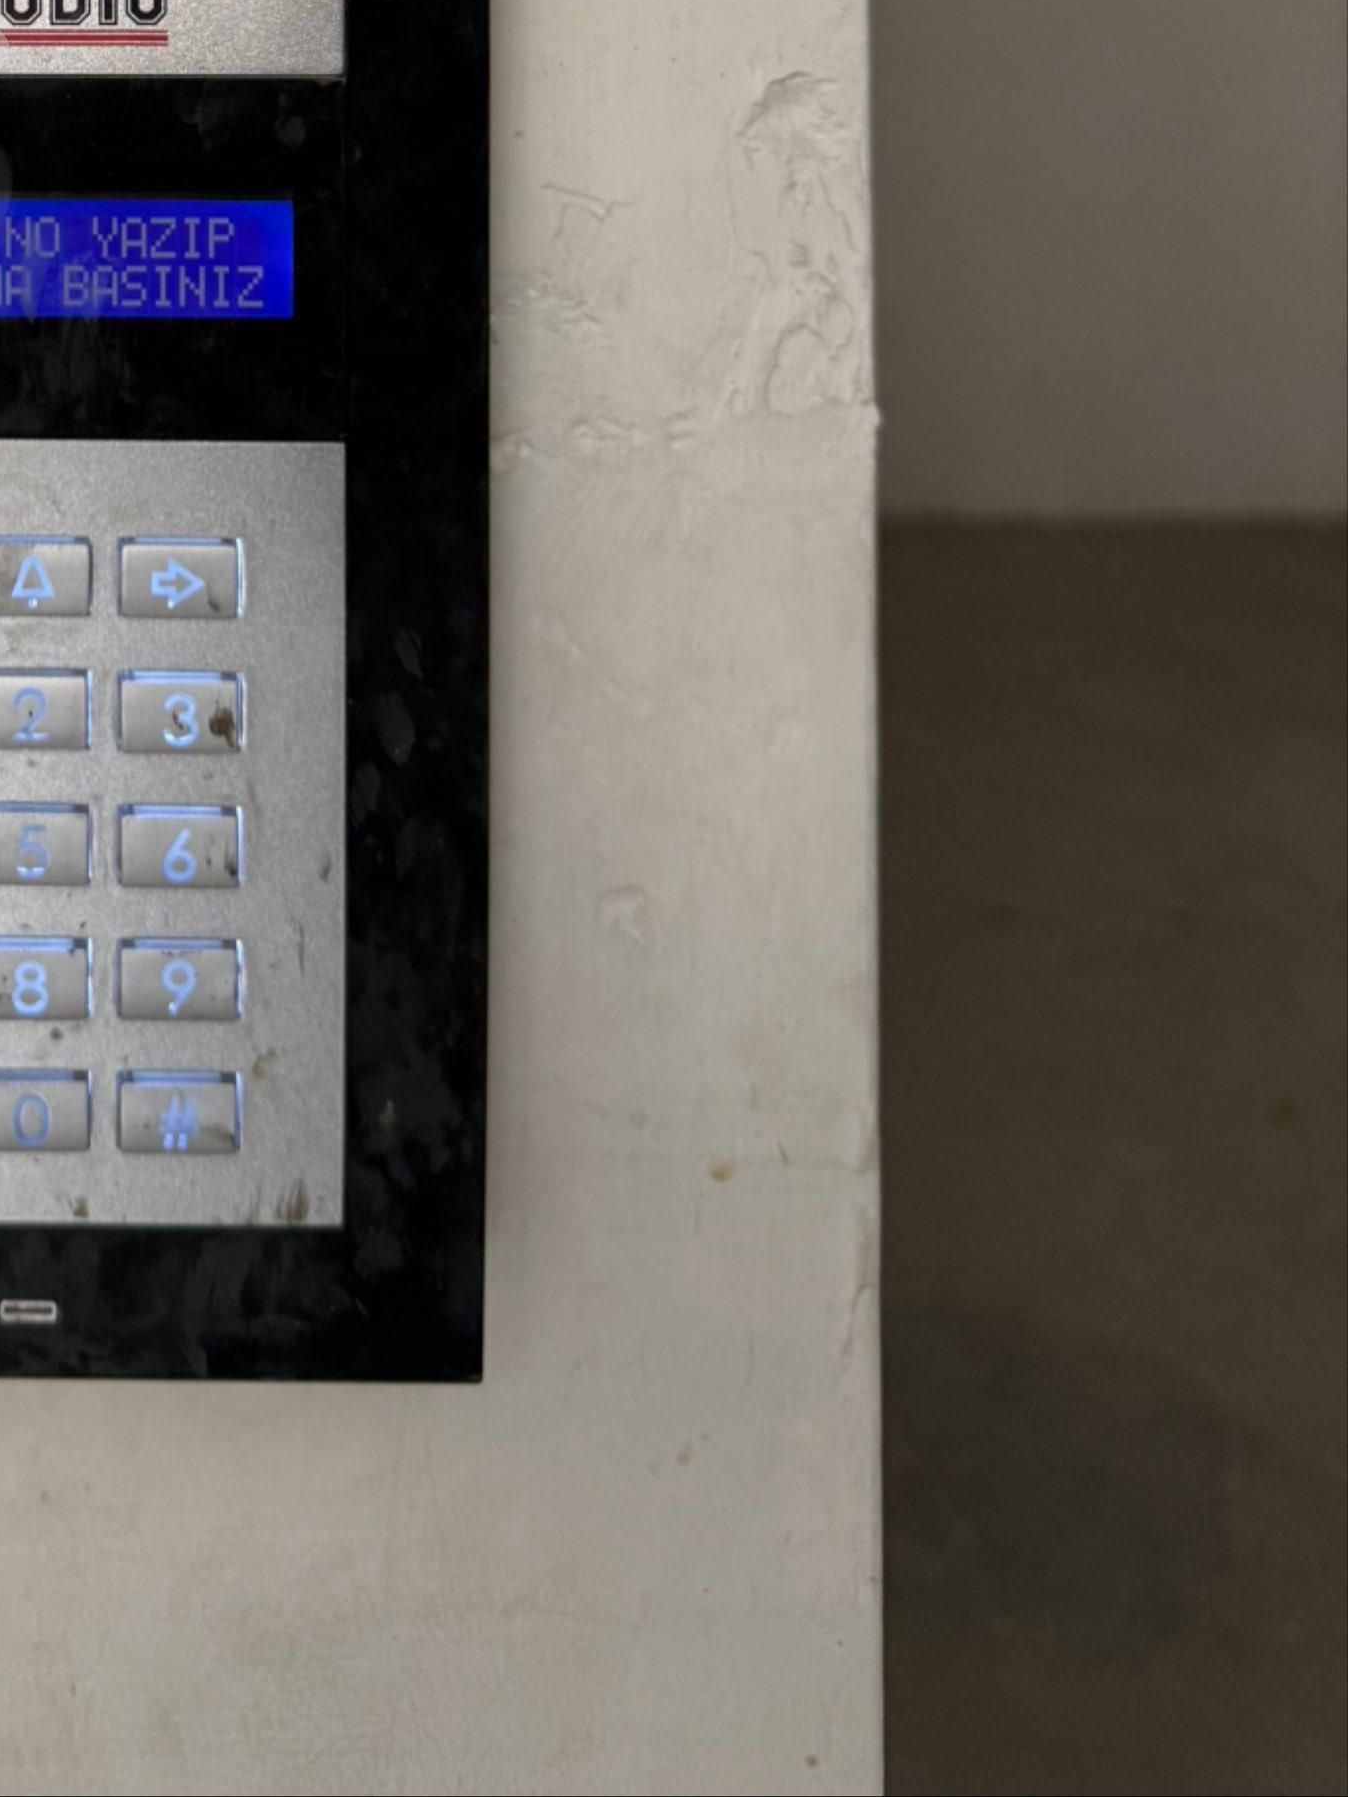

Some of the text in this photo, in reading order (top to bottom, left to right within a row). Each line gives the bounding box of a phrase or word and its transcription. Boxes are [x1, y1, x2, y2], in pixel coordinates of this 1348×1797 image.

[6, 216, 60, 259] NO
[93, 216, 235, 259] YAZIP
[63, 266, 264, 309] BASINIZ
[14, 688, 47, 740] 2
[163, 695, 198, 745] 3
[15, 826, 48, 878] 5
[163, 829, 196, 882] 6
[13, 961, 48, 1014] 8
[161, 962, 196, 1014] 9
[13, 1094, 48, 1146] 0
